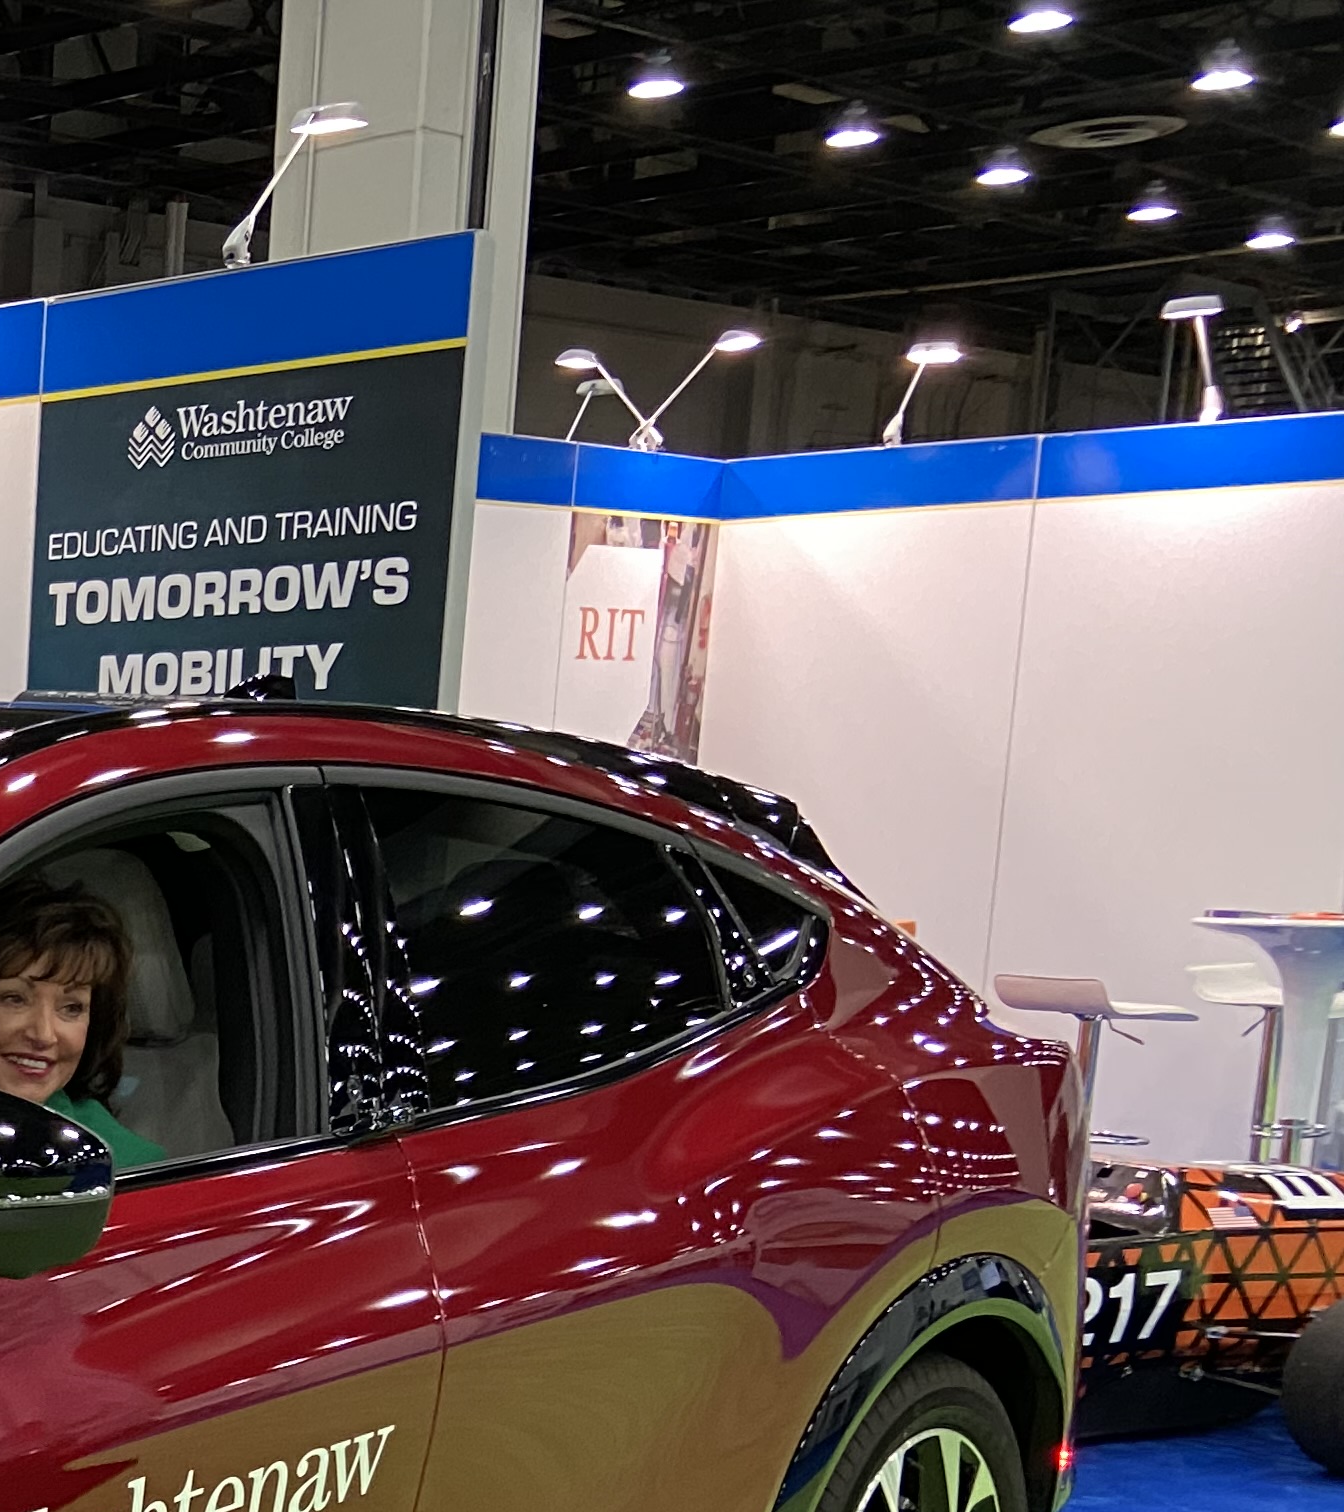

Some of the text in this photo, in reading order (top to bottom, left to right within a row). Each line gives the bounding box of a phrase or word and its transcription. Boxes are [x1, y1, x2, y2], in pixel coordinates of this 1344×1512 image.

[176, 395, 354, 439] Washtenaw
[181, 427, 345, 461] Community College
[47, 500, 418, 561] EDUCATING AND TRAINING
[48, 556, 410, 627] TOMORROW'S
[575, 606, 646, 662] RIT
[97, 642, 344, 696] MOBILITY
